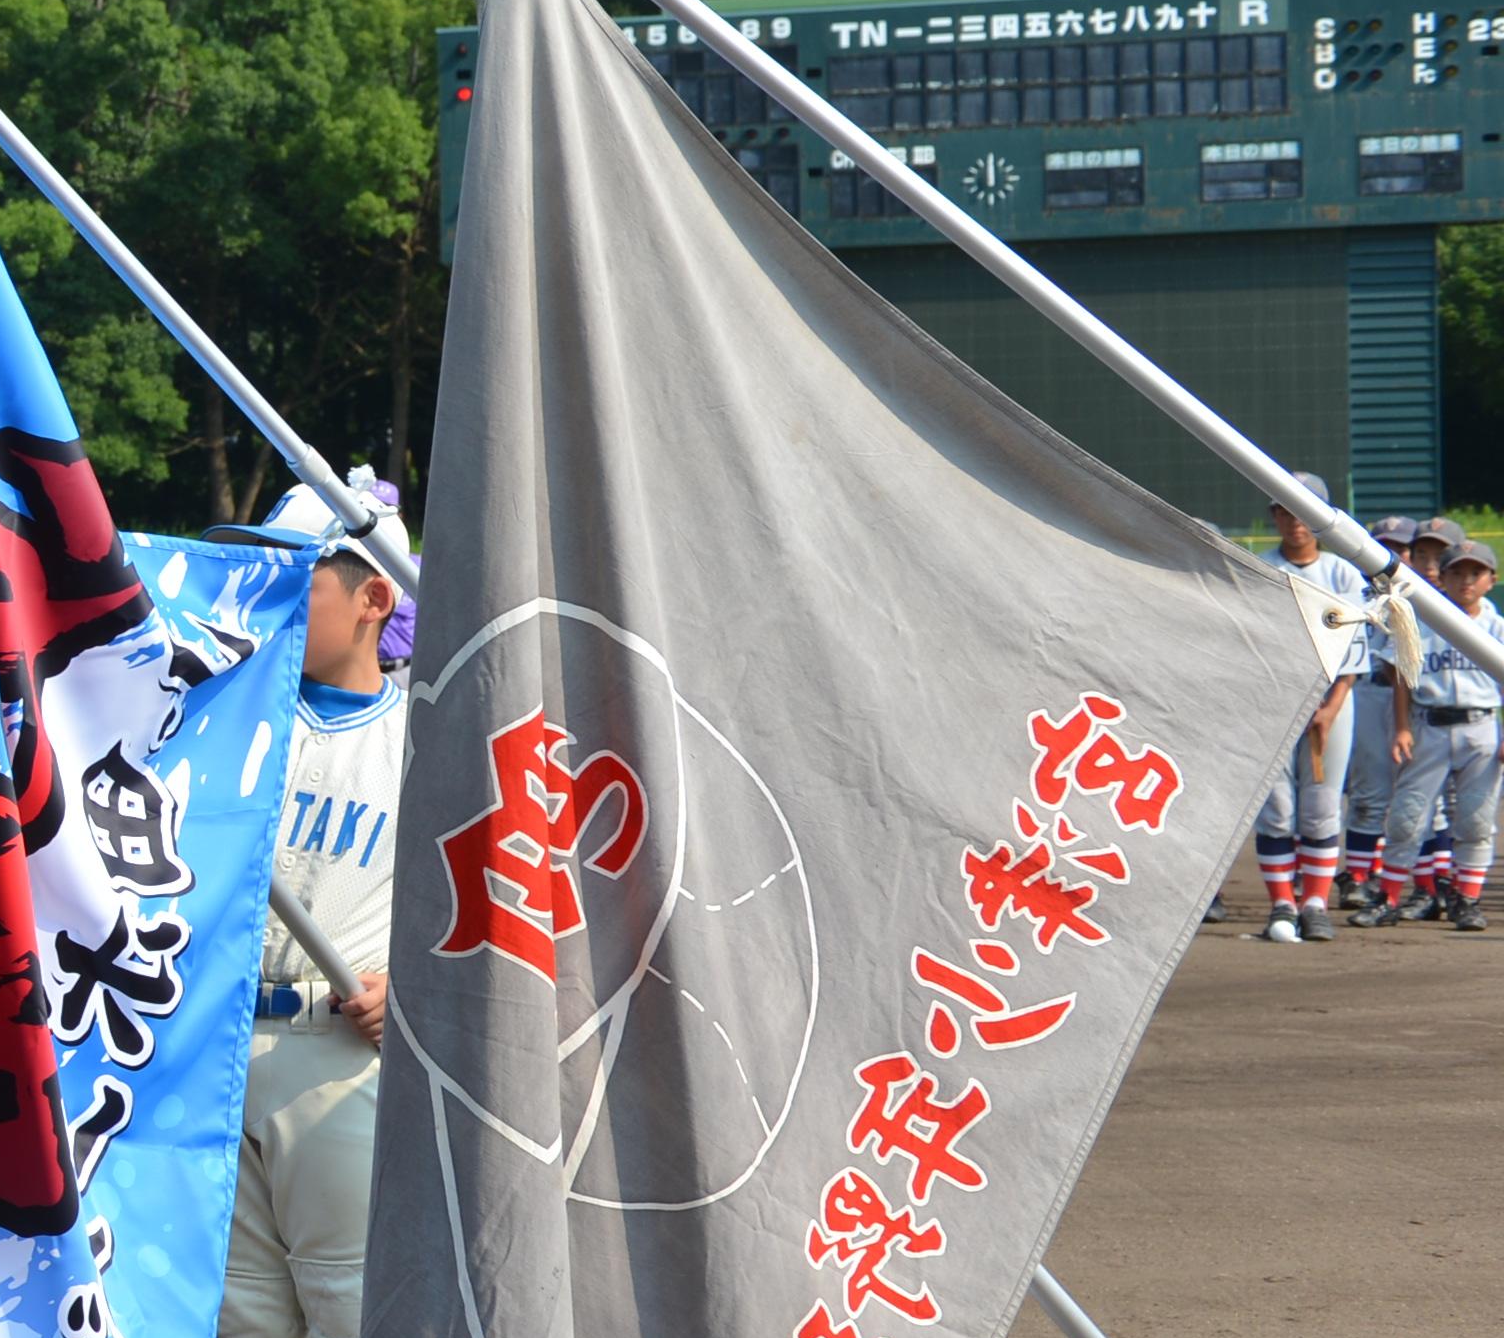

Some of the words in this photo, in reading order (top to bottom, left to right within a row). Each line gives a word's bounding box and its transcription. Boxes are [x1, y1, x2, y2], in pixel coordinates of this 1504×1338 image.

[646, 24, 668, 47] 5
[771, 16, 793, 39] 9
[831, 19, 887, 49] TN
[1314, 17, 1337, 40] S
[1412, 11, 1437, 35] H
[1314, 41, 1337, 66] B
[1413, 36, 1437, 59] E
[287, 790, 387, 868] TAKI
